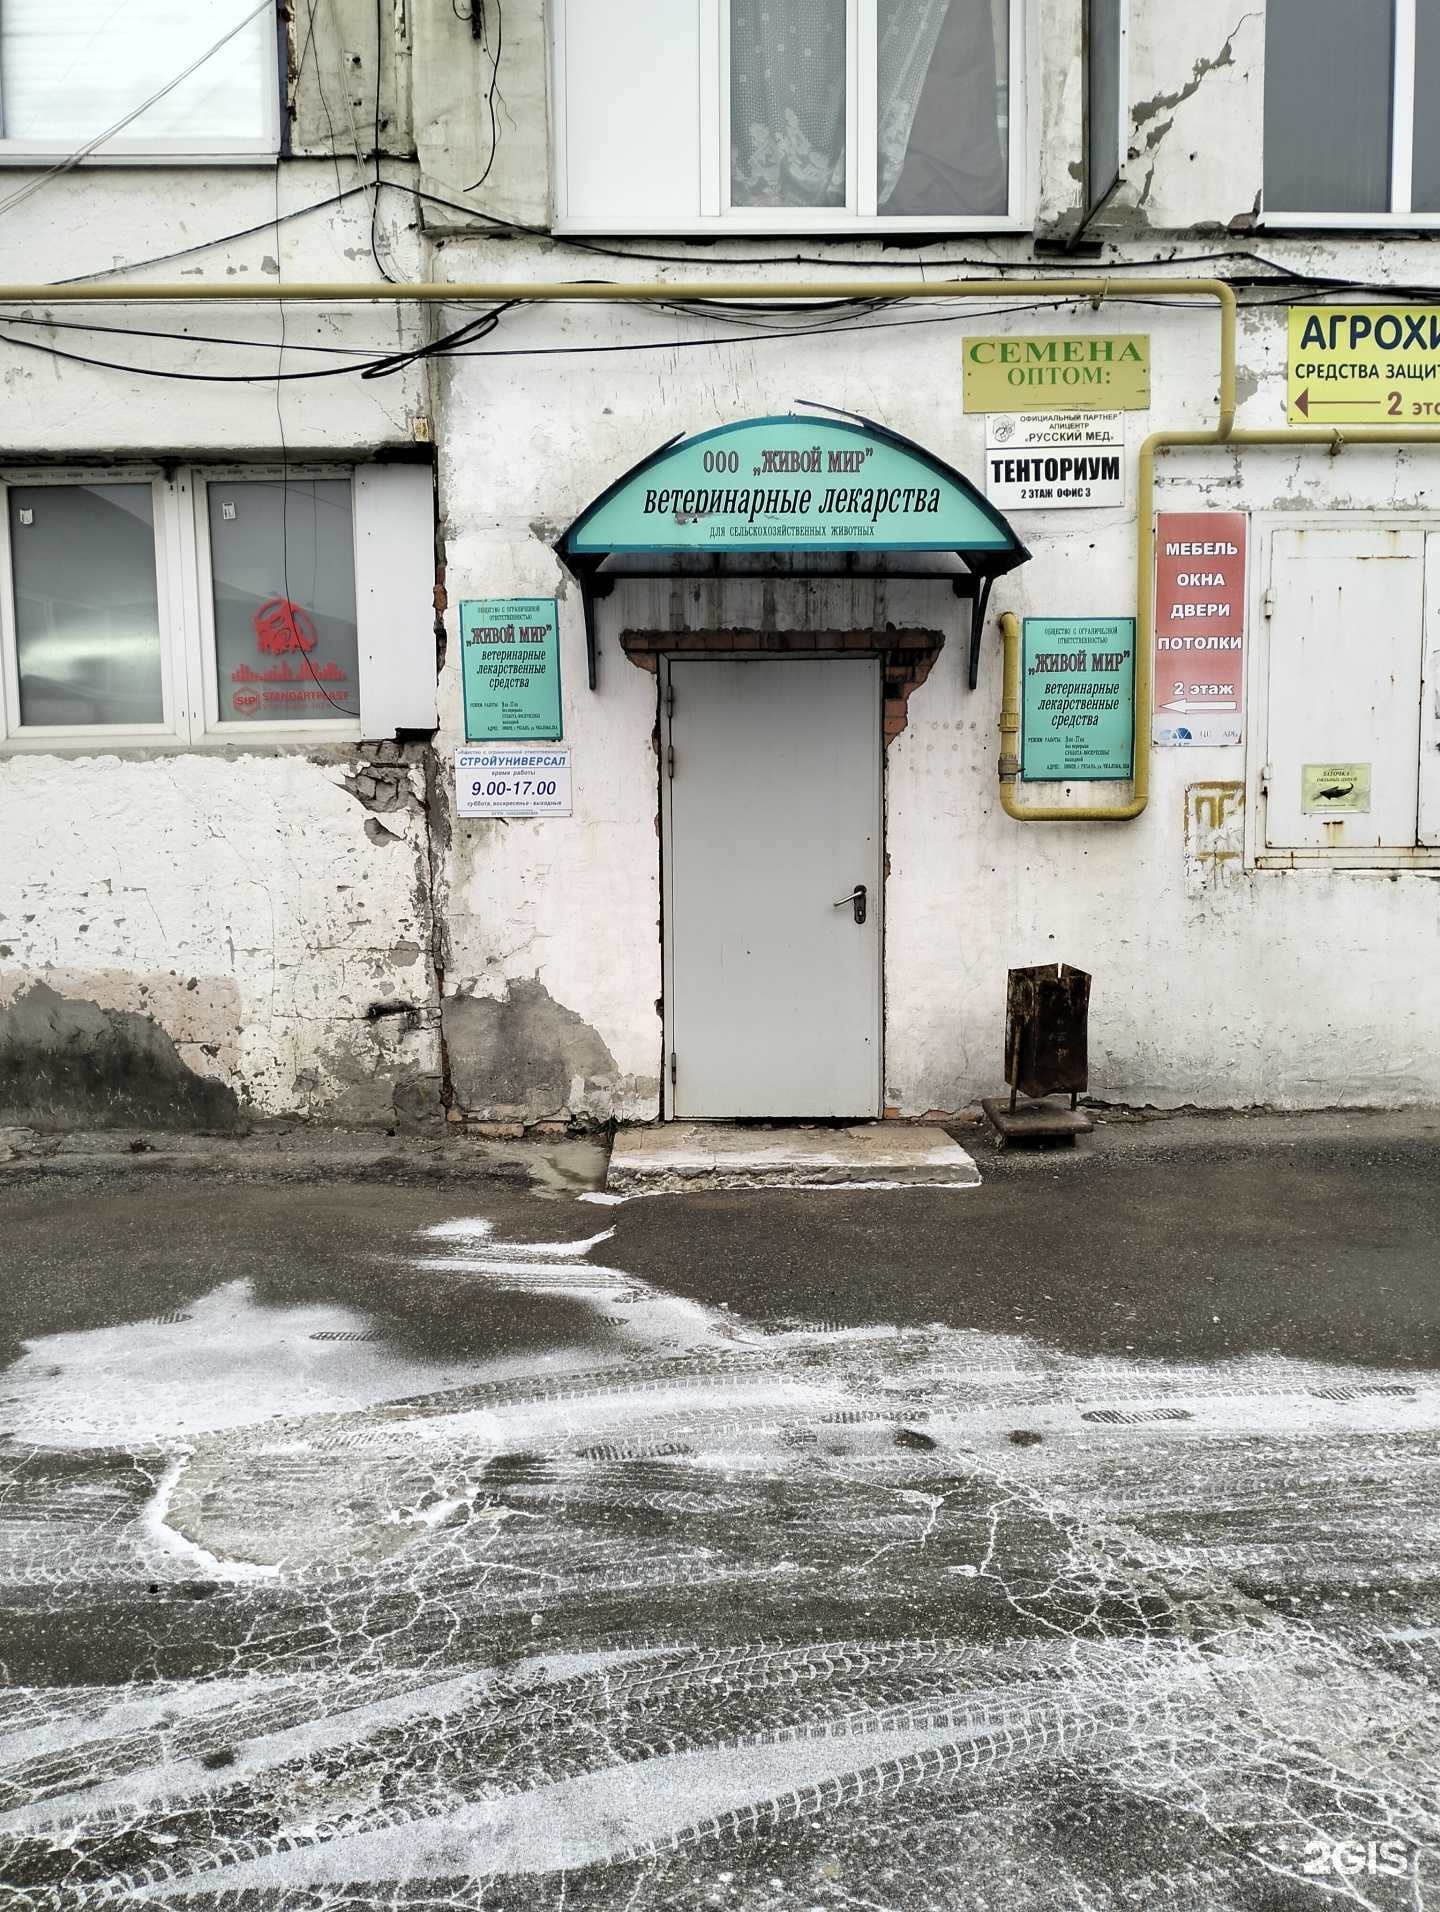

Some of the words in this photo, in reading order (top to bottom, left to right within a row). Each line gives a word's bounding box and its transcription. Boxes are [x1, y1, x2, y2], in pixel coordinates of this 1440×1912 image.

[969, 340, 1143, 364] СЕМЕНА
[1007, 366, 1111, 386] ОПТОМ:
[1295, 363, 1380, 381] СРЕДСТВА
[1387, 391, 1403, 416] 2
[1019, 414, 1081, 423] ОФИЦИАЛЬНЫЙ
[1083, 413, 1118, 422] ПАРТНЕР
[1048, 422, 1090, 431] АПИЦЕНТР
[702, 450, 739, 474] ООО
[991, 456, 1120, 483] ТЕНТОРИУМ
[1021, 489, 1028, 499] 2
[1028, 488, 1054, 499] ЭТАЖ
[1056, 488, 1084, 498] ОФИС
[1084, 488, 1091, 498] 3
[644, 487, 810, 523] ветеринарные
[818, 486, 941, 523] лекарства
[709, 523, 726, 538] ДЛЯ
[729, 522, 826, 537] СЕЛЬСКОХОЗЯЙСТВЕННЫХ
[830, 522, 875, 537] ЖИВОТНЫХ
[1165, 541, 1239, 556] МЕБЕЛЬ
[1176, 572, 1226, 587] ОКНА
[1170, 603, 1231, 620] ДВЕРИ
[1156, 635, 1243, 651] ПОТОЛКИ
[481, 650, 546, 663] ветеринарные
[477, 664, 546, 678] лекарственные
[489, 679, 529, 690] средства
[1044, 683, 1120, 698] ветеринарные
[1173, 681, 1185, 696] 2
[1189, 683, 1235, 696] этаж
[1037, 699, 1120, 715] лекарственные
[1051, 714, 1099, 730] средства
[459, 754, 567, 767] СТРОЙУНИВЕРСАЛ
[512, 769, 536, 777] работы
[471, 780, 557, 796] 9.00-17.00
